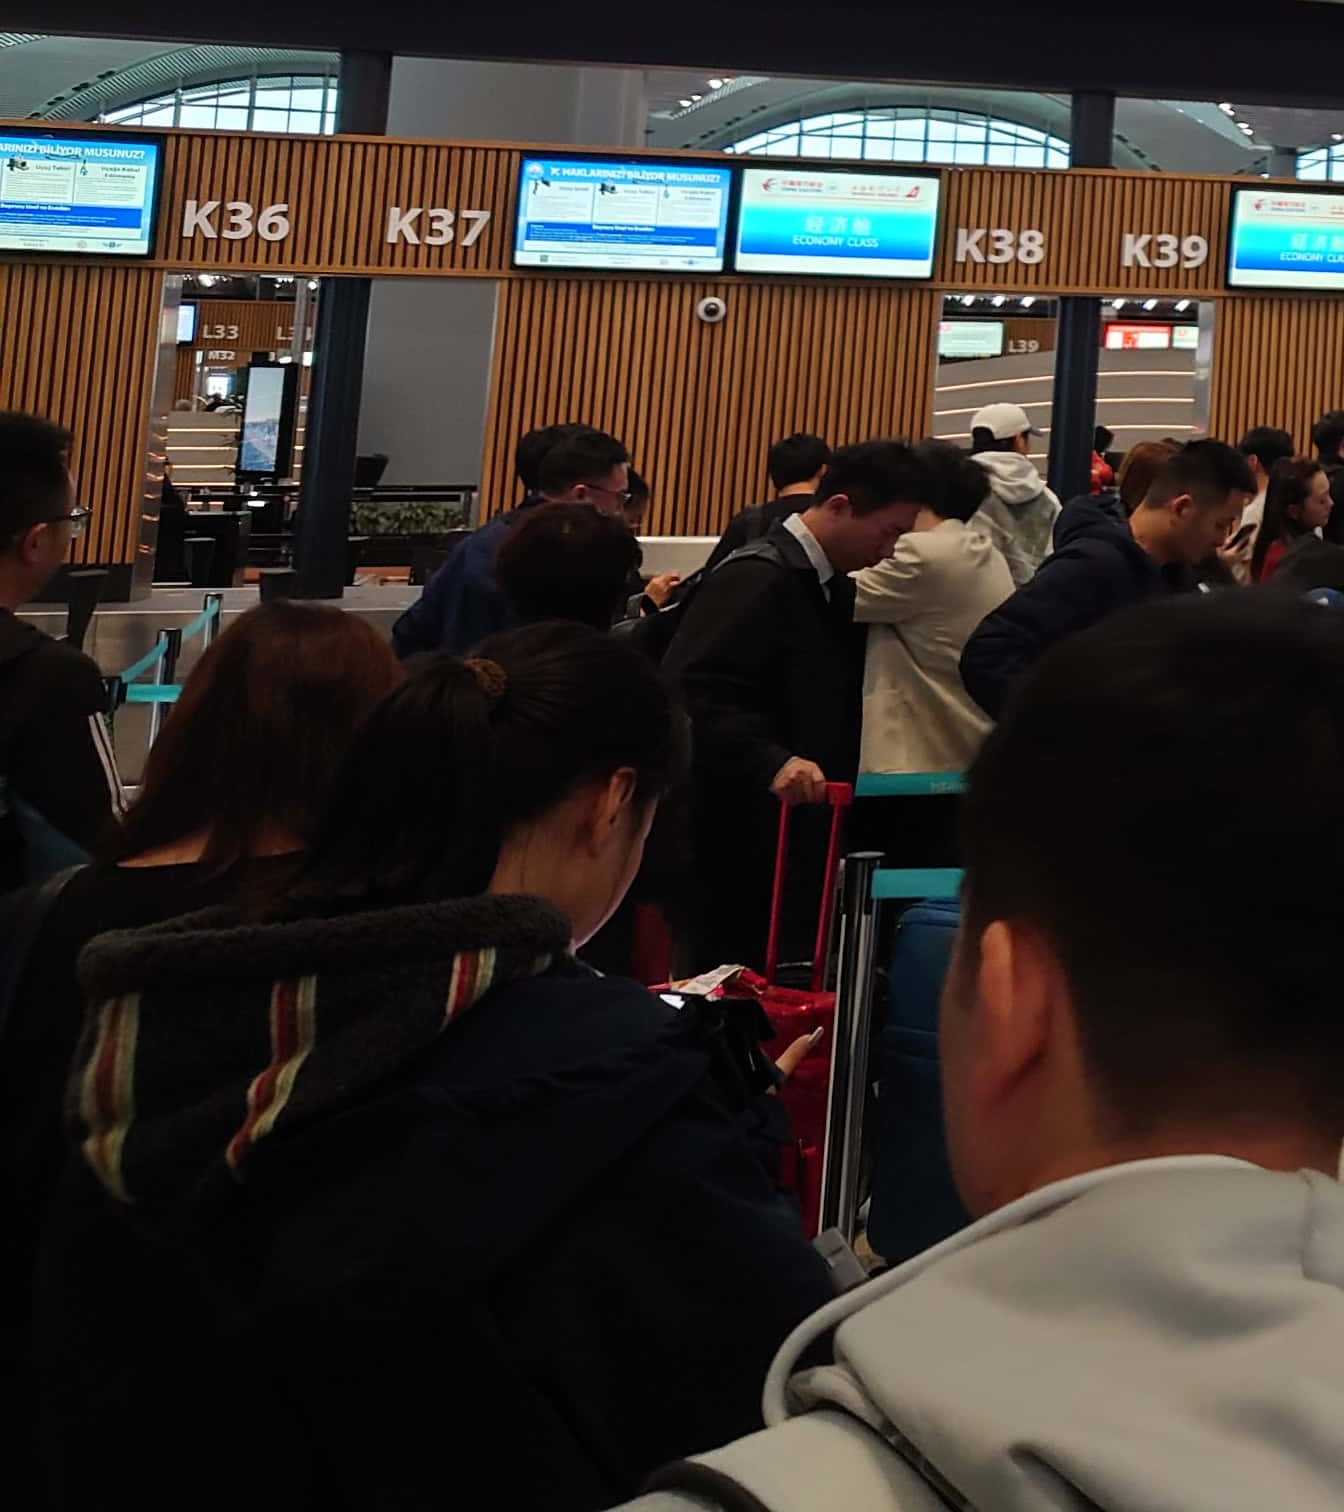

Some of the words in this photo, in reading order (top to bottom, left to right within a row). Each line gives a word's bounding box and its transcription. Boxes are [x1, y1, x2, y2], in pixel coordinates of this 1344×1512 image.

[182, 199, 290, 241] K36
[386, 206, 491, 247] K37
[792, 234, 844, 247] ECONOMY
[847, 236, 879, 248] CLASS
[955, 228, 1046, 265] K38
[1121, 233, 1209, 269] K39
[203, 324, 240, 340] L33
[1008, 339, 1040, 353] L39
